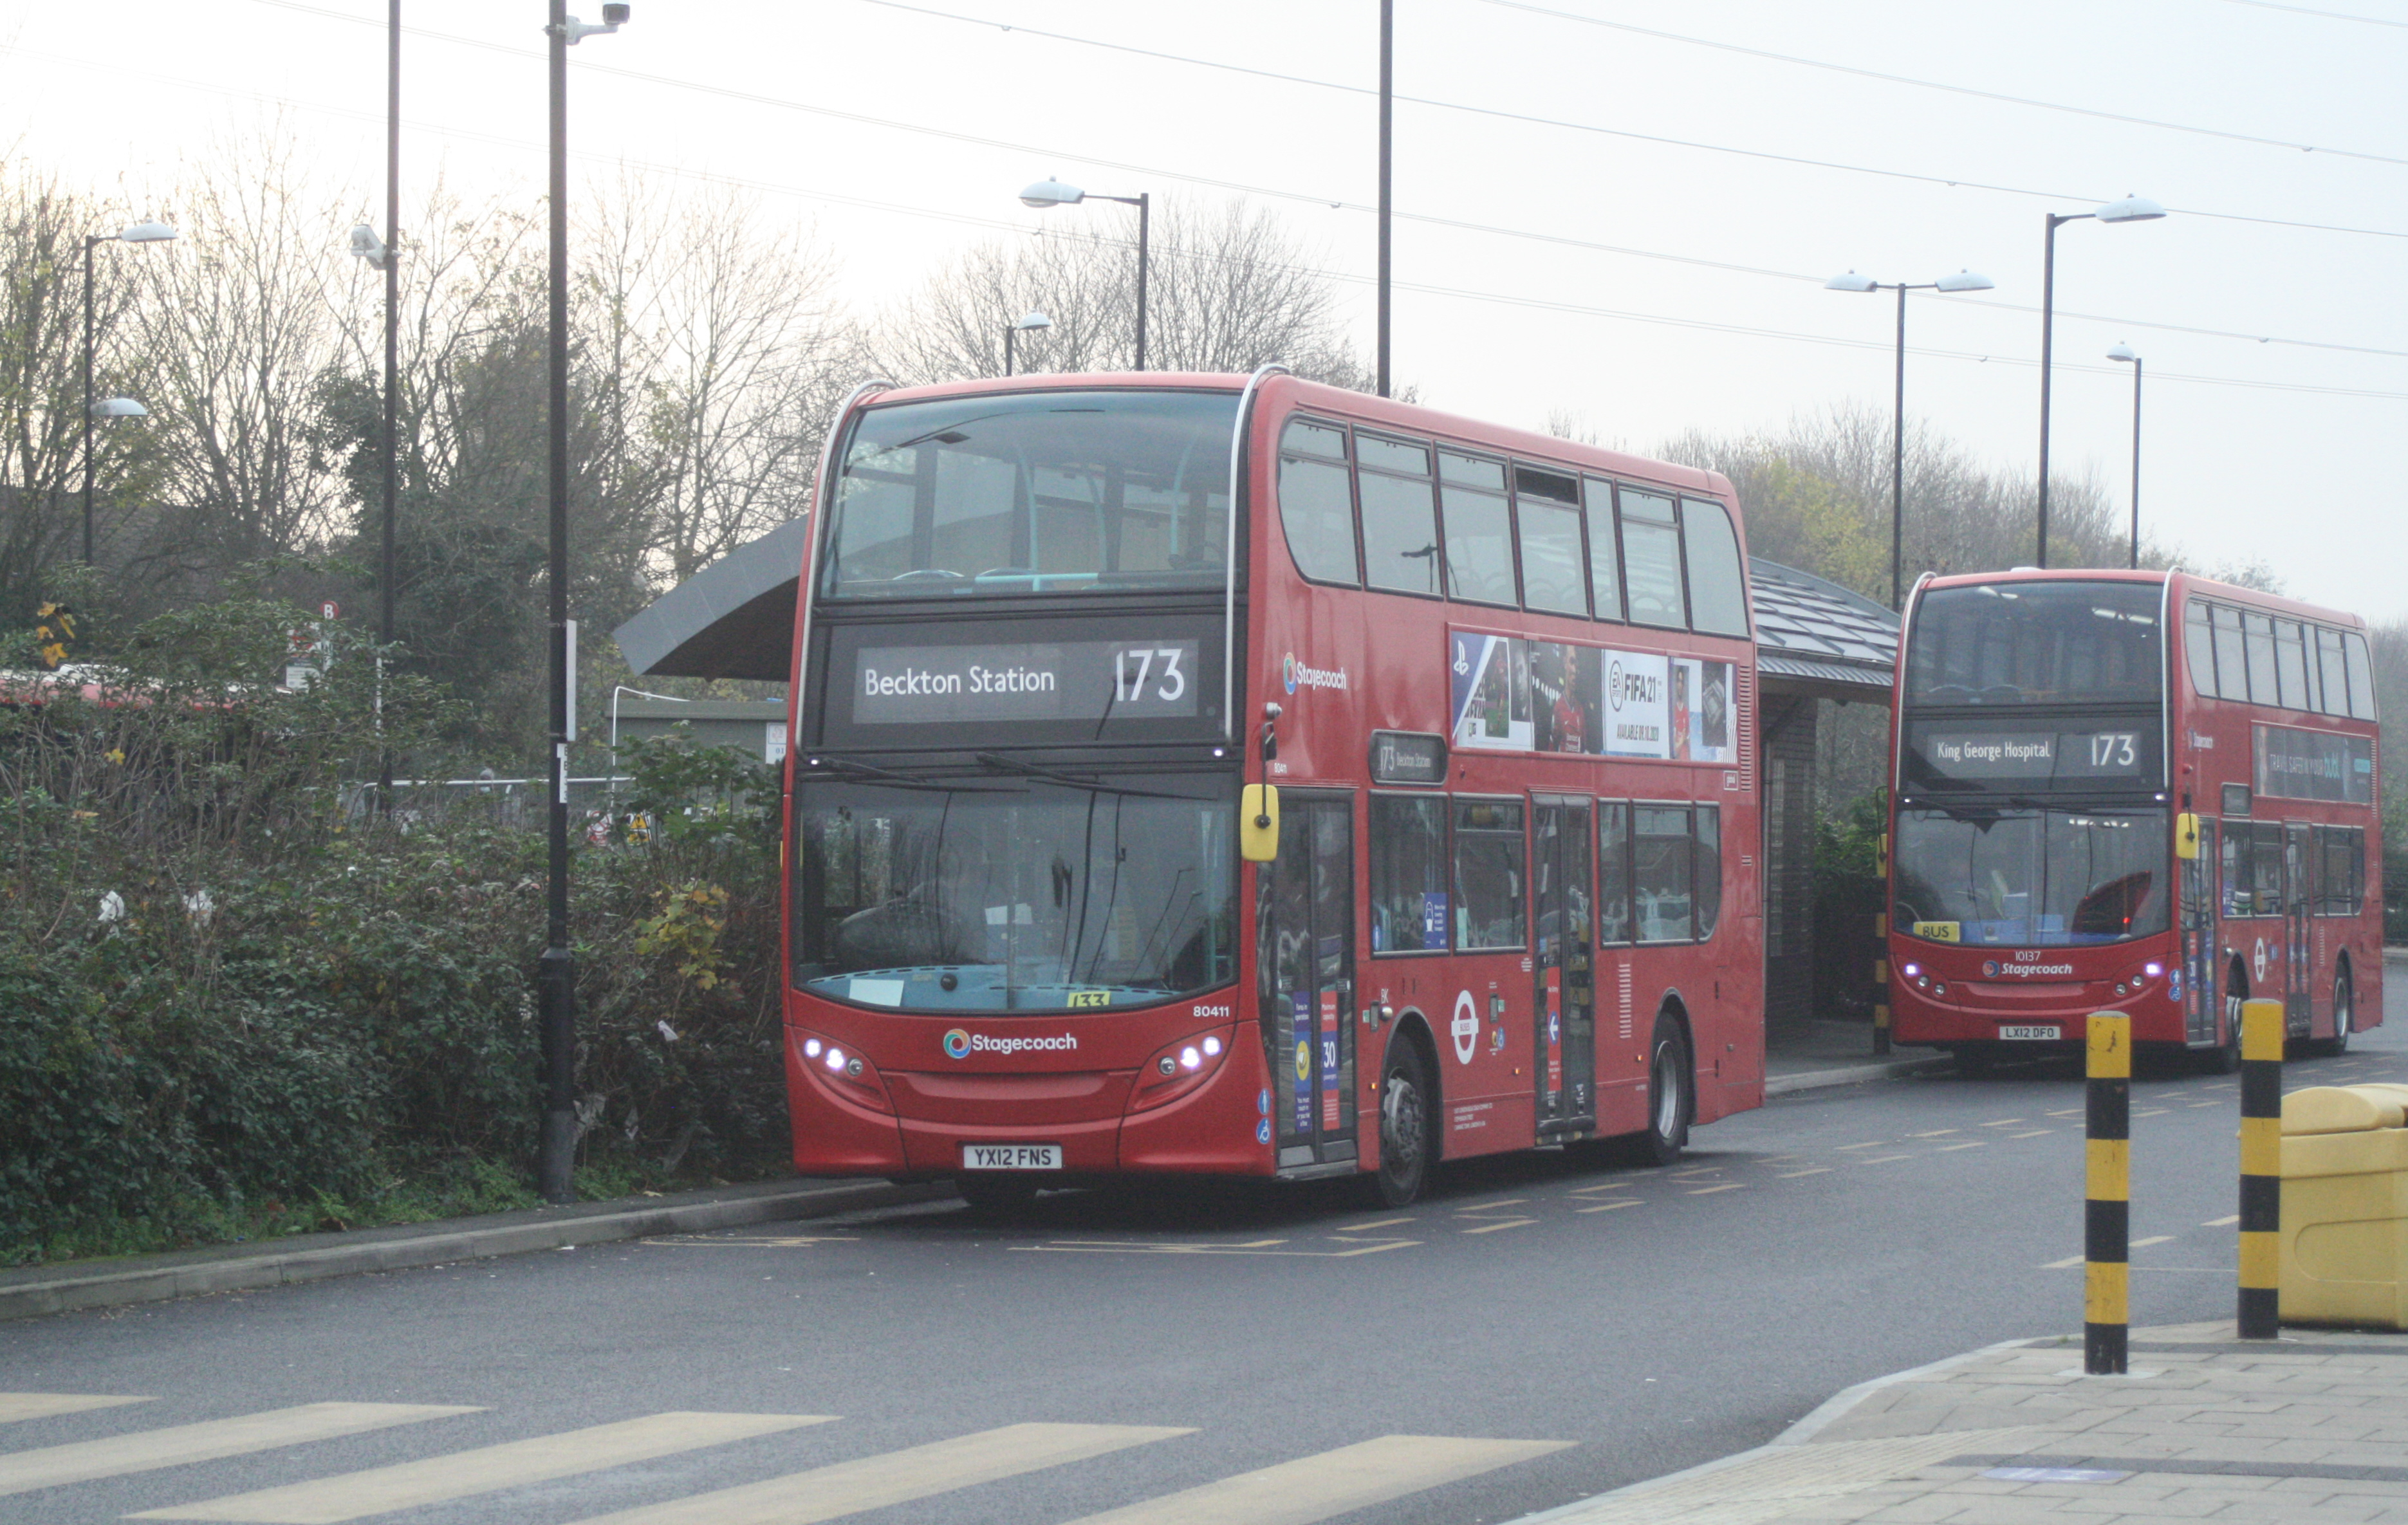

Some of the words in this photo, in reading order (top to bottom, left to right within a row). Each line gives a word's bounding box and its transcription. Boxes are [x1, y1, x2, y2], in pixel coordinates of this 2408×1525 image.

[324, 604, 335, 620] B
[865, 667, 961, 696] Beckton
[969, 665, 1055, 693] Station
[1115, 648, 1185, 701] 173
[1296, 661, 1347, 690] Stagecoach
[1624, 673, 1647, 702] FIFA
[1647, 676, 1656, 703] 21
[1380, 746, 1394, 771] 173
[1937, 741, 1961, 762] King
[1964, 741, 2001, 761] George
[2005, 741, 2050, 762] Hospital
[2091, 735, 2135, 766] 173
[1922, 925, 1949, 938] BUS
[2015, 950, 2041, 961] 10137
[2001, 963, 2073, 977] Stagecoach
[1073, 994, 1105, 1007] 133
[1192, 1005, 1230, 1017] 80411
[972, 1032, 1078, 1055] Stagecoach
[2005, 1028, 2030, 1038] LX12
[1323, 1040, 1336, 1068] 30
[974, 1149, 1012, 1165] YX12
[1017, 1149, 1051, 1165] FNS
